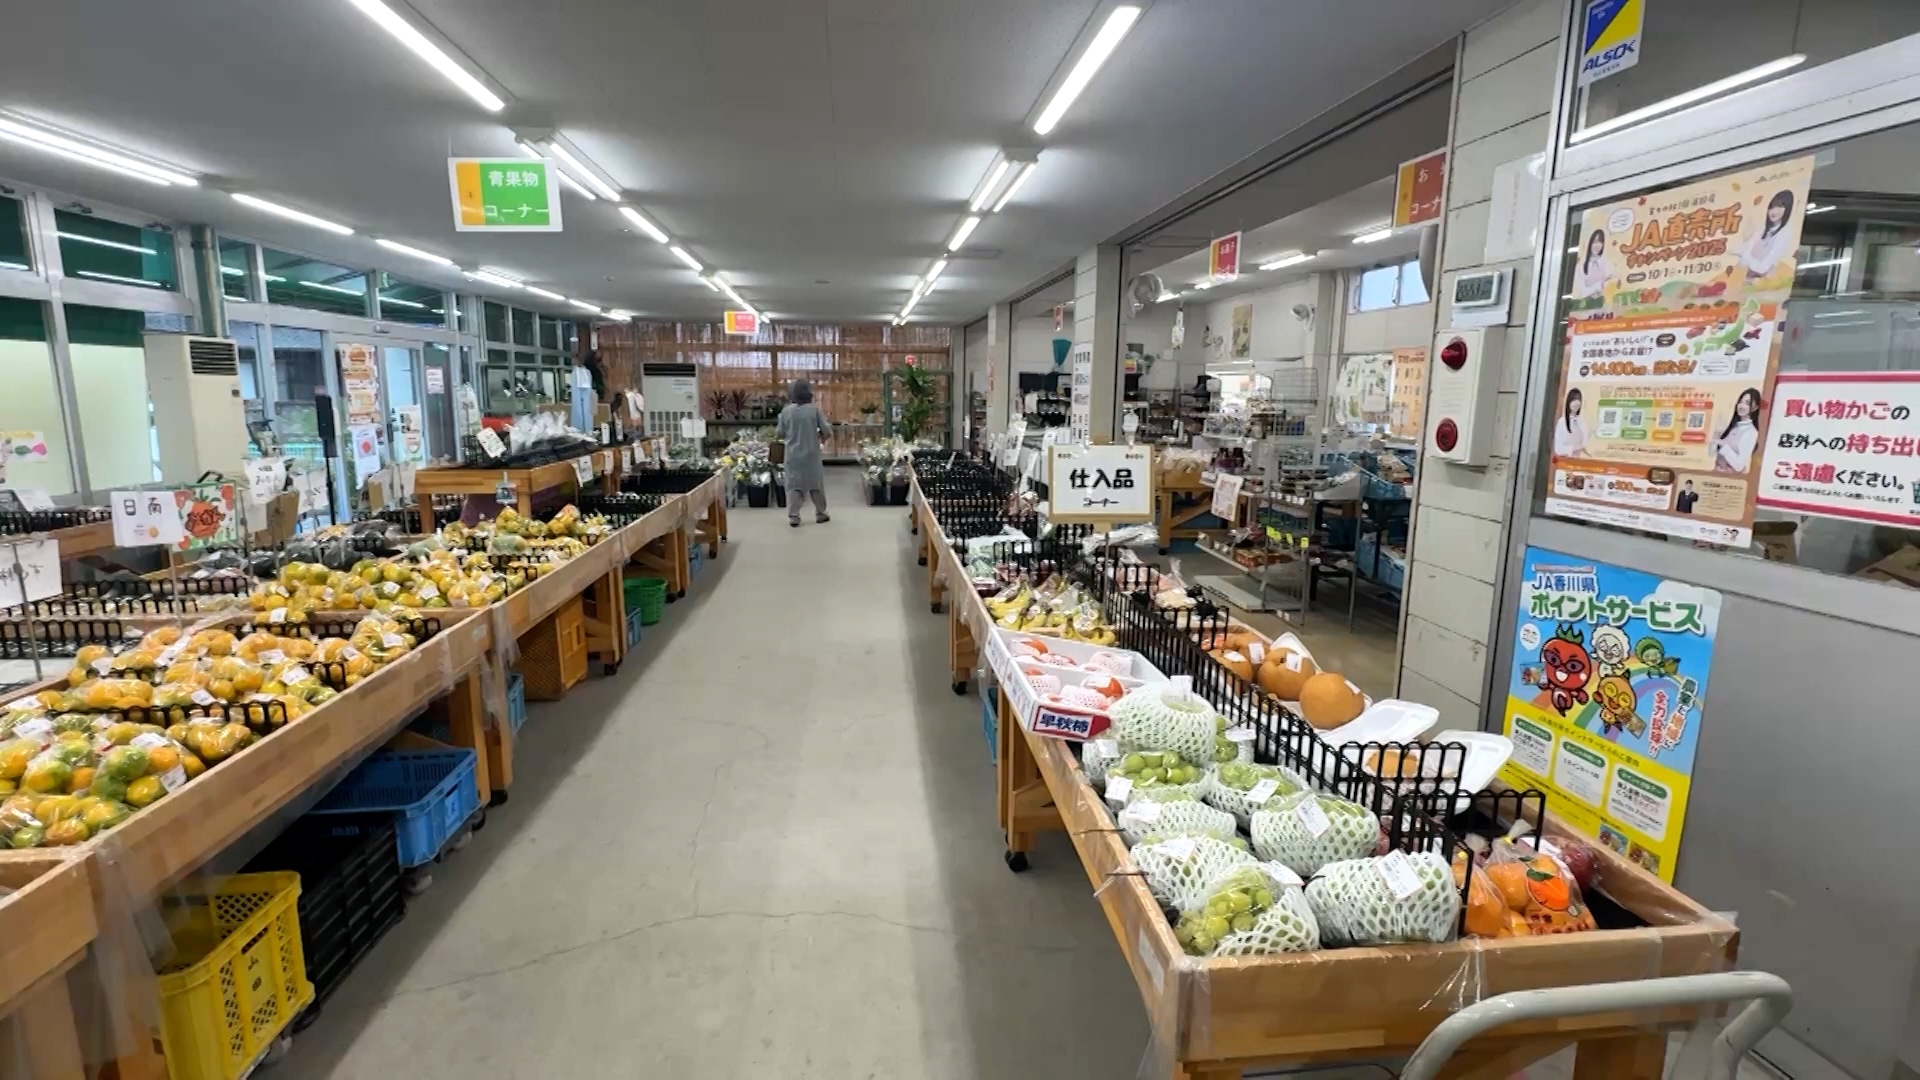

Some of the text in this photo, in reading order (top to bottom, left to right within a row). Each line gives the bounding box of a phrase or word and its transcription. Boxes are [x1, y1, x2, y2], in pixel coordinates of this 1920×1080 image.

[1582, 39, 1636, 73] ALSOK
[488, 169, 539, 188] 青果物
[484, 203, 549, 221] コーナー
[1621, 201, 1743, 253] JA直売所
[1784, 399, 1910, 421] 買い物かごの
[1069, 467, 1134, 490] 仕入品
[1774, 461, 1904, 490] ご遠慮ください。
[1083, 497, 1120, 508] コーナー
[1531, 575, 1596, 592] JA香川県
[1531, 593, 1702, 631] ポイントサービス
[1039, 713, 1091, 734] 早秋柿
